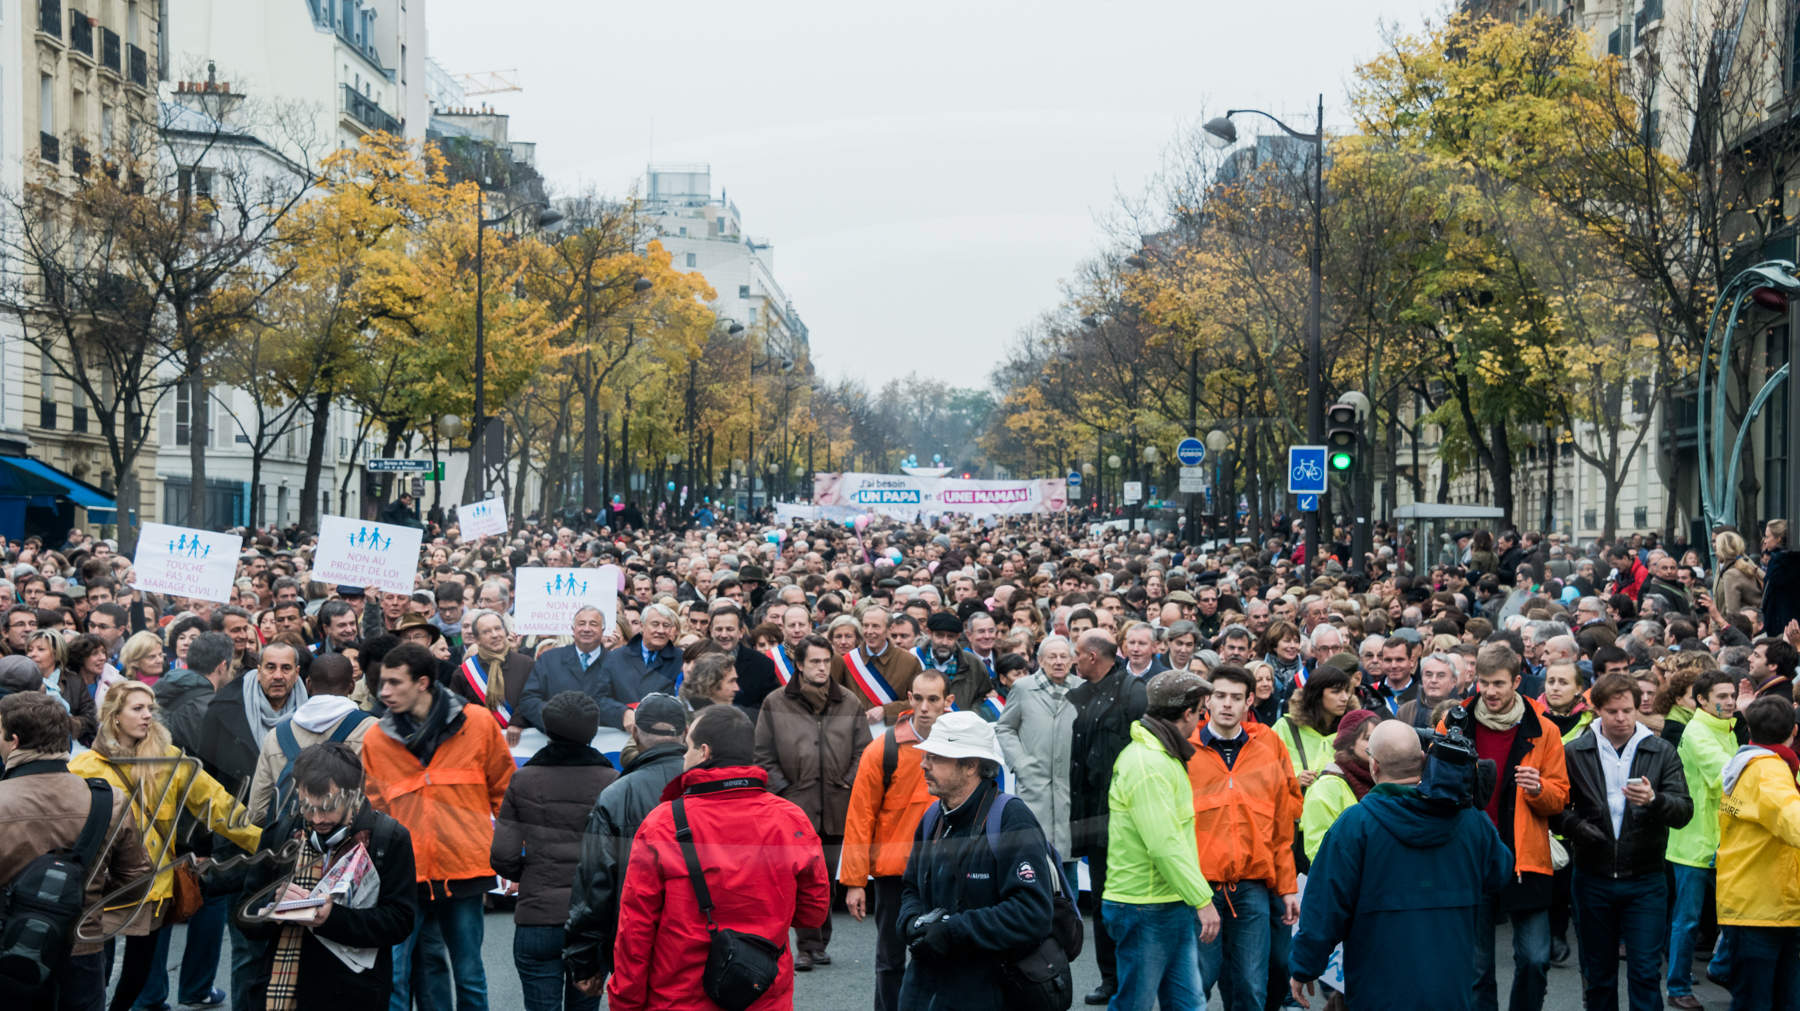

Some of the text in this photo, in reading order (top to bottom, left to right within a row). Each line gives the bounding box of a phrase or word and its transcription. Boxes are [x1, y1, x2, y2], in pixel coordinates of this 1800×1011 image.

[860, 480, 906, 488] J'ai besoin
[882, 491, 918, 502] PAPA
[975, 490, 1026, 502] MAMAN
[347, 553, 386, 566] NON AU
[165, 560, 206, 573] TOUCHE
[330, 560, 399, 578] PROJET DE LOI
[165, 572, 200, 583] PAS AU
[144, 578, 185, 592] MARIAGE
[546, 601, 569, 610] NON
[530, 611, 566, 620] PROJET
